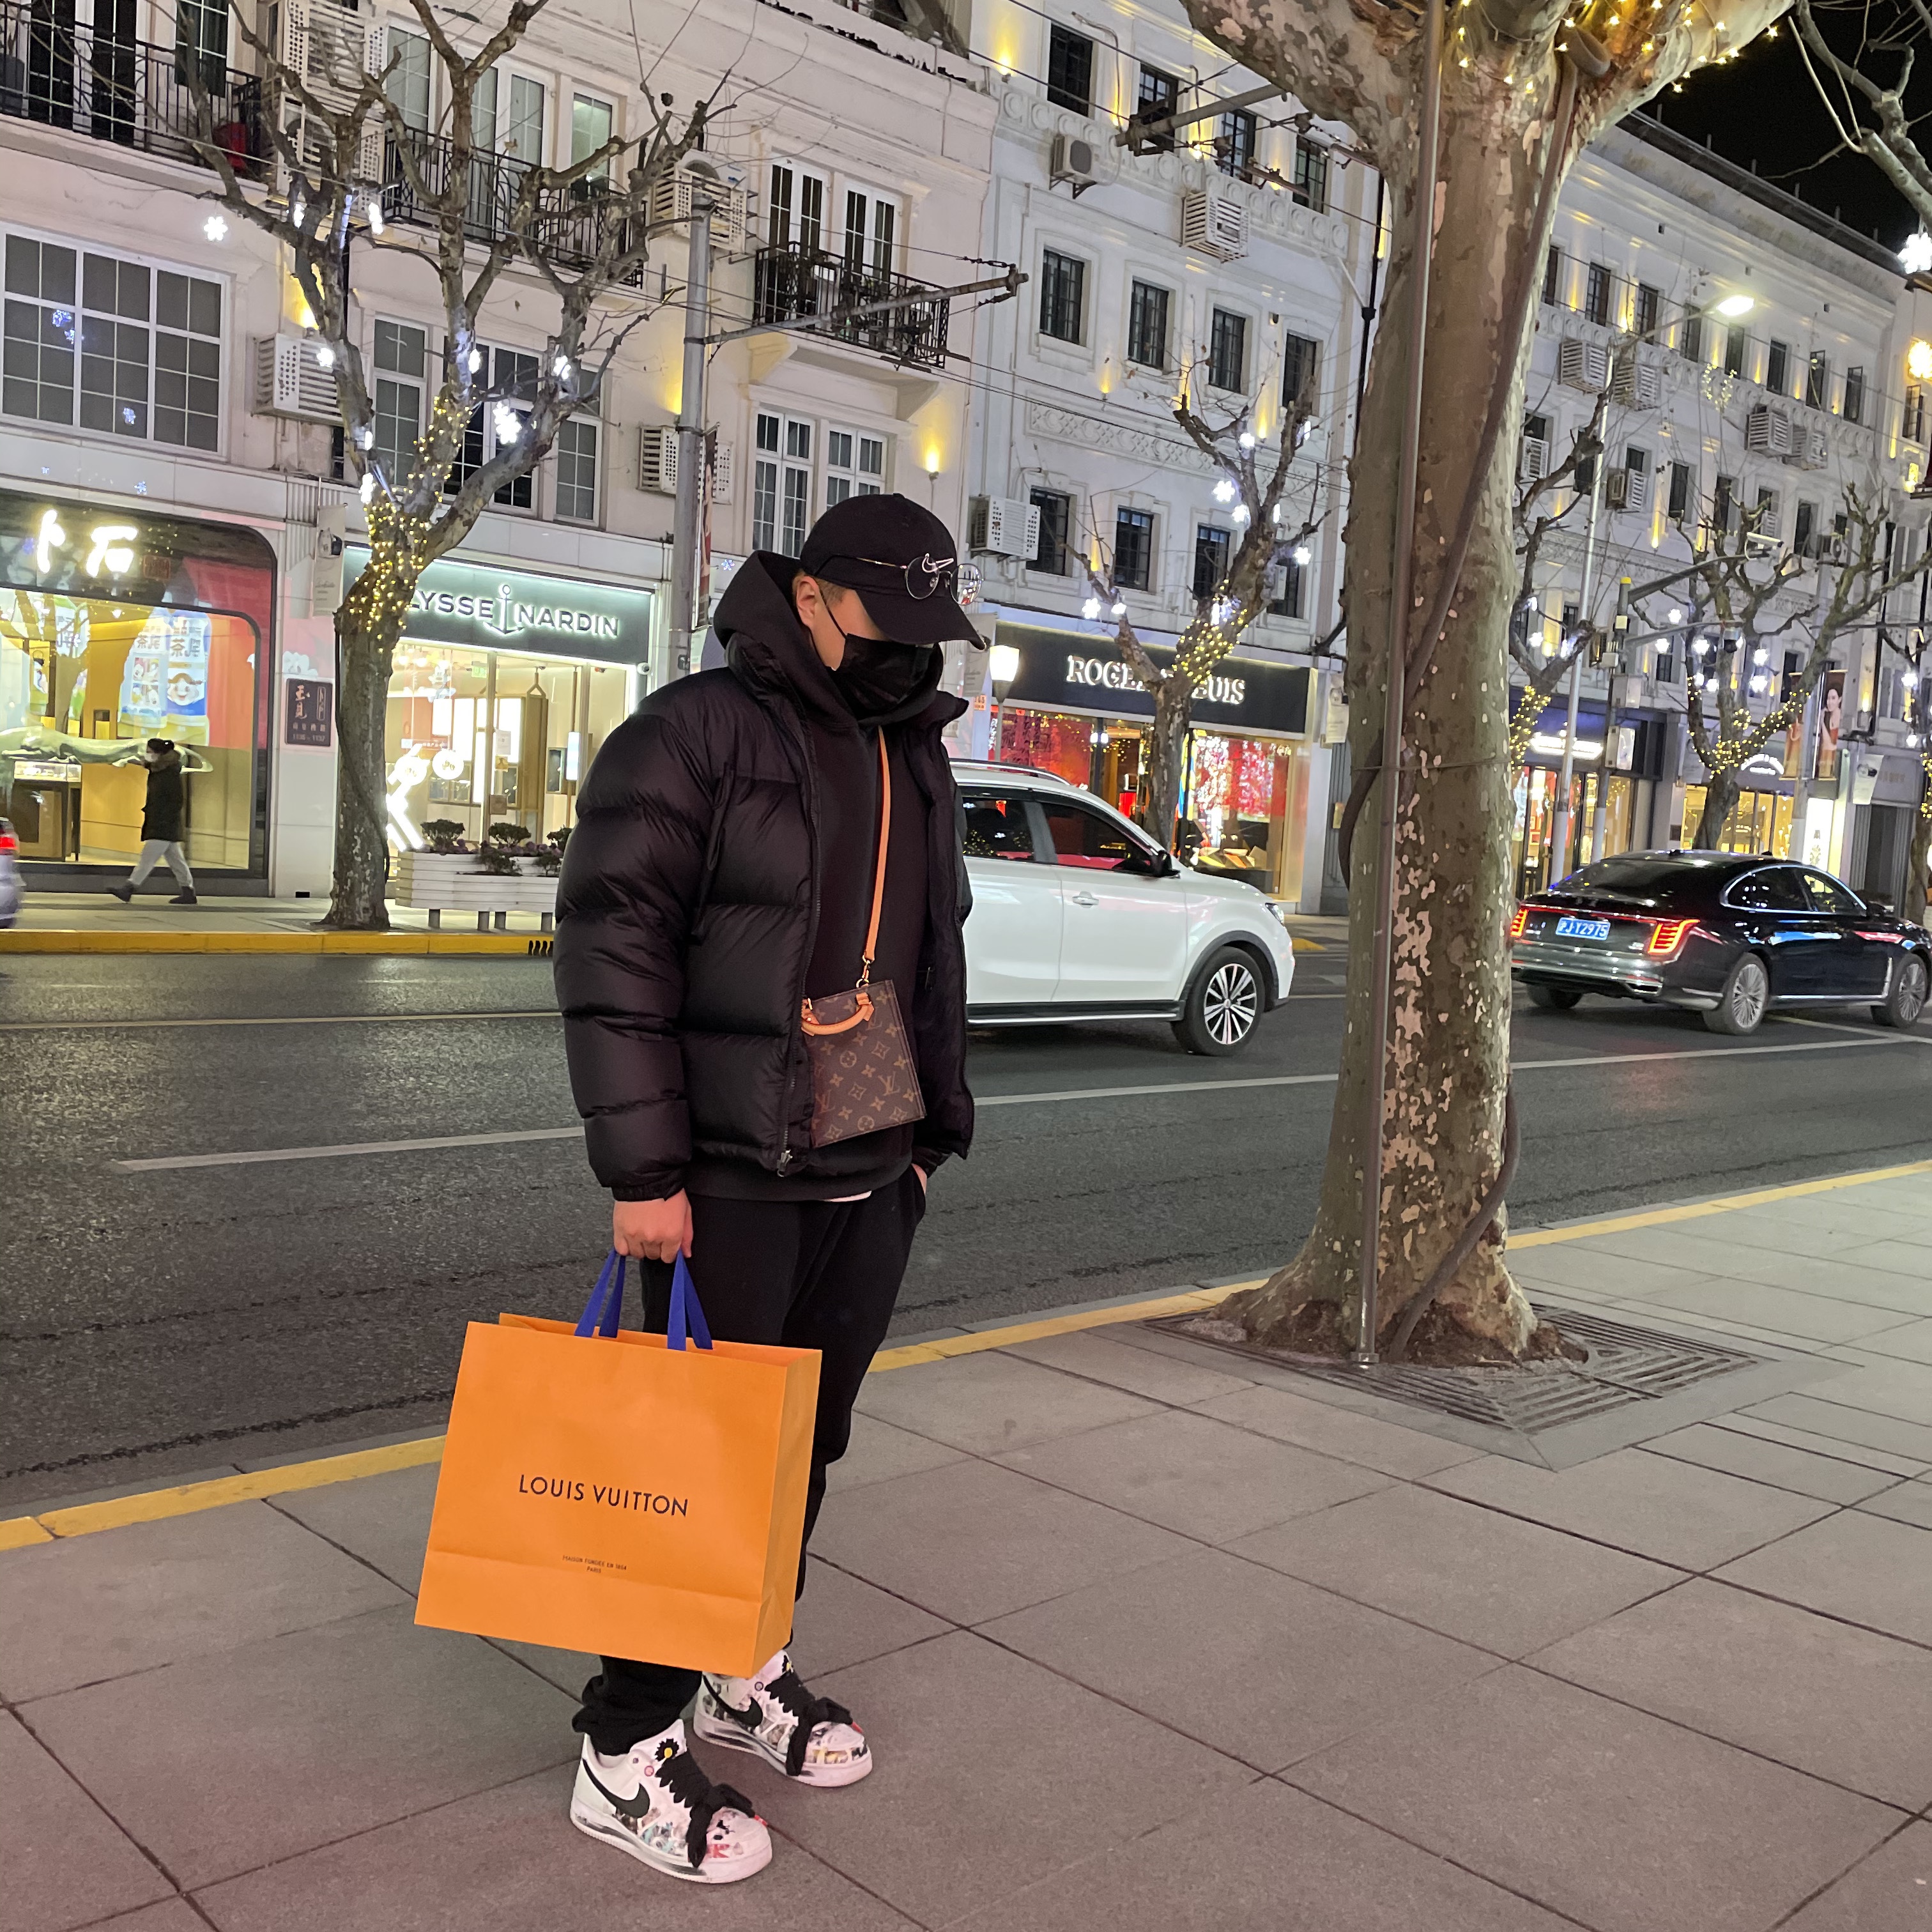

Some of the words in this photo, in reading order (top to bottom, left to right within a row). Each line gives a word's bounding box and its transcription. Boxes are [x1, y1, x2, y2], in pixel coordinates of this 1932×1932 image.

[516, 603, 619, 637] NARDIN
[1066, 655, 1149, 692] ROGE
[519, 1474, 585, 1501] LOUIS
[593, 1484, 689, 1517] VUITTON
